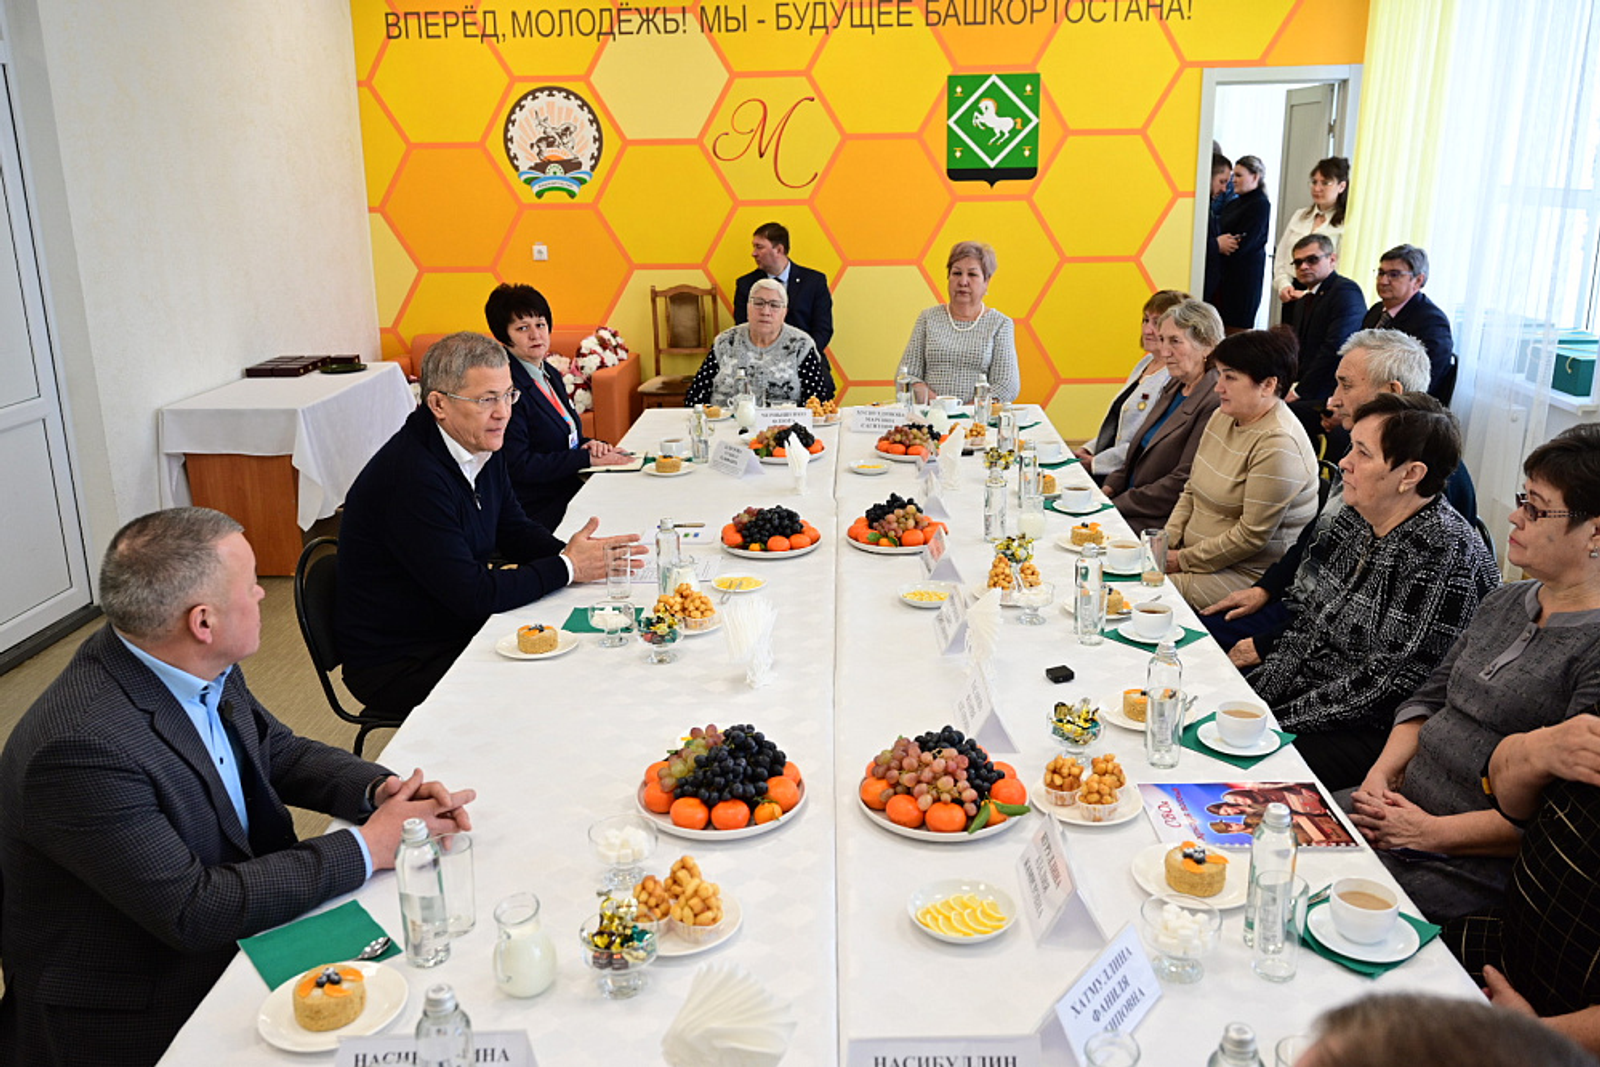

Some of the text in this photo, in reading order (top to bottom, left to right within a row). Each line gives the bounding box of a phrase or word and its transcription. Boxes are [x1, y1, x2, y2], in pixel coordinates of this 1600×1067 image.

[384, 5, 506, 43] ВПЕРЁД,
[511, 3, 688, 42] МОЛОДЁЖЬ!
[700, 4, 747, 34] МЫ
[775, 0, 914, 36] БУДУЩЕЕ
[925, 0, 1193, 27] БАШКОРТОСТАНА!
[1070, 946, 1133, 1019] ХАТМУЛЛИНА
[1092, 974, 1131, 1022] ФАНИЛЯ
[874, 1055, 1018, 1067] НАСИБУЛЛИН
